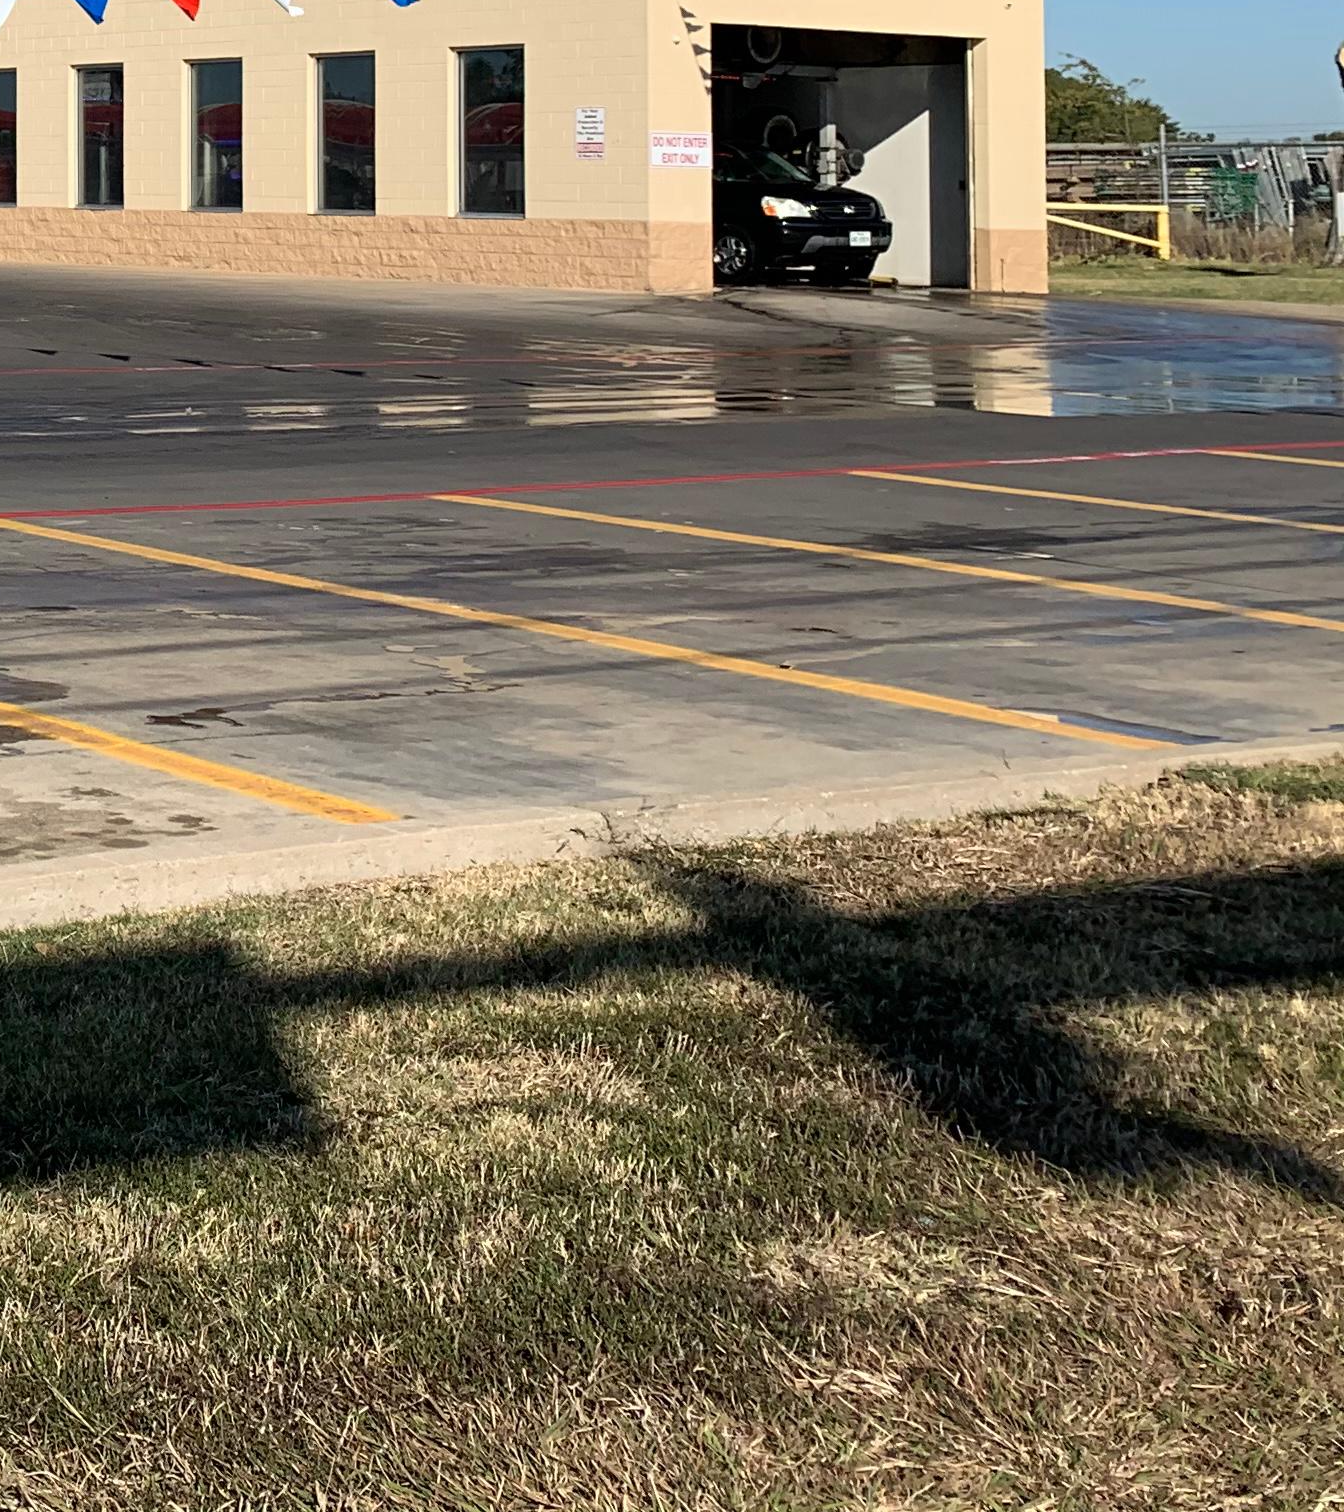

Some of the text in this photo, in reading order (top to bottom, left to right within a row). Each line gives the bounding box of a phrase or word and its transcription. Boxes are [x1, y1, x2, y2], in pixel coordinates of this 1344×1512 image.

[652, 136, 708, 148] DO NOT ENTER
[662, 152, 700, 164] EXIT ONLY
